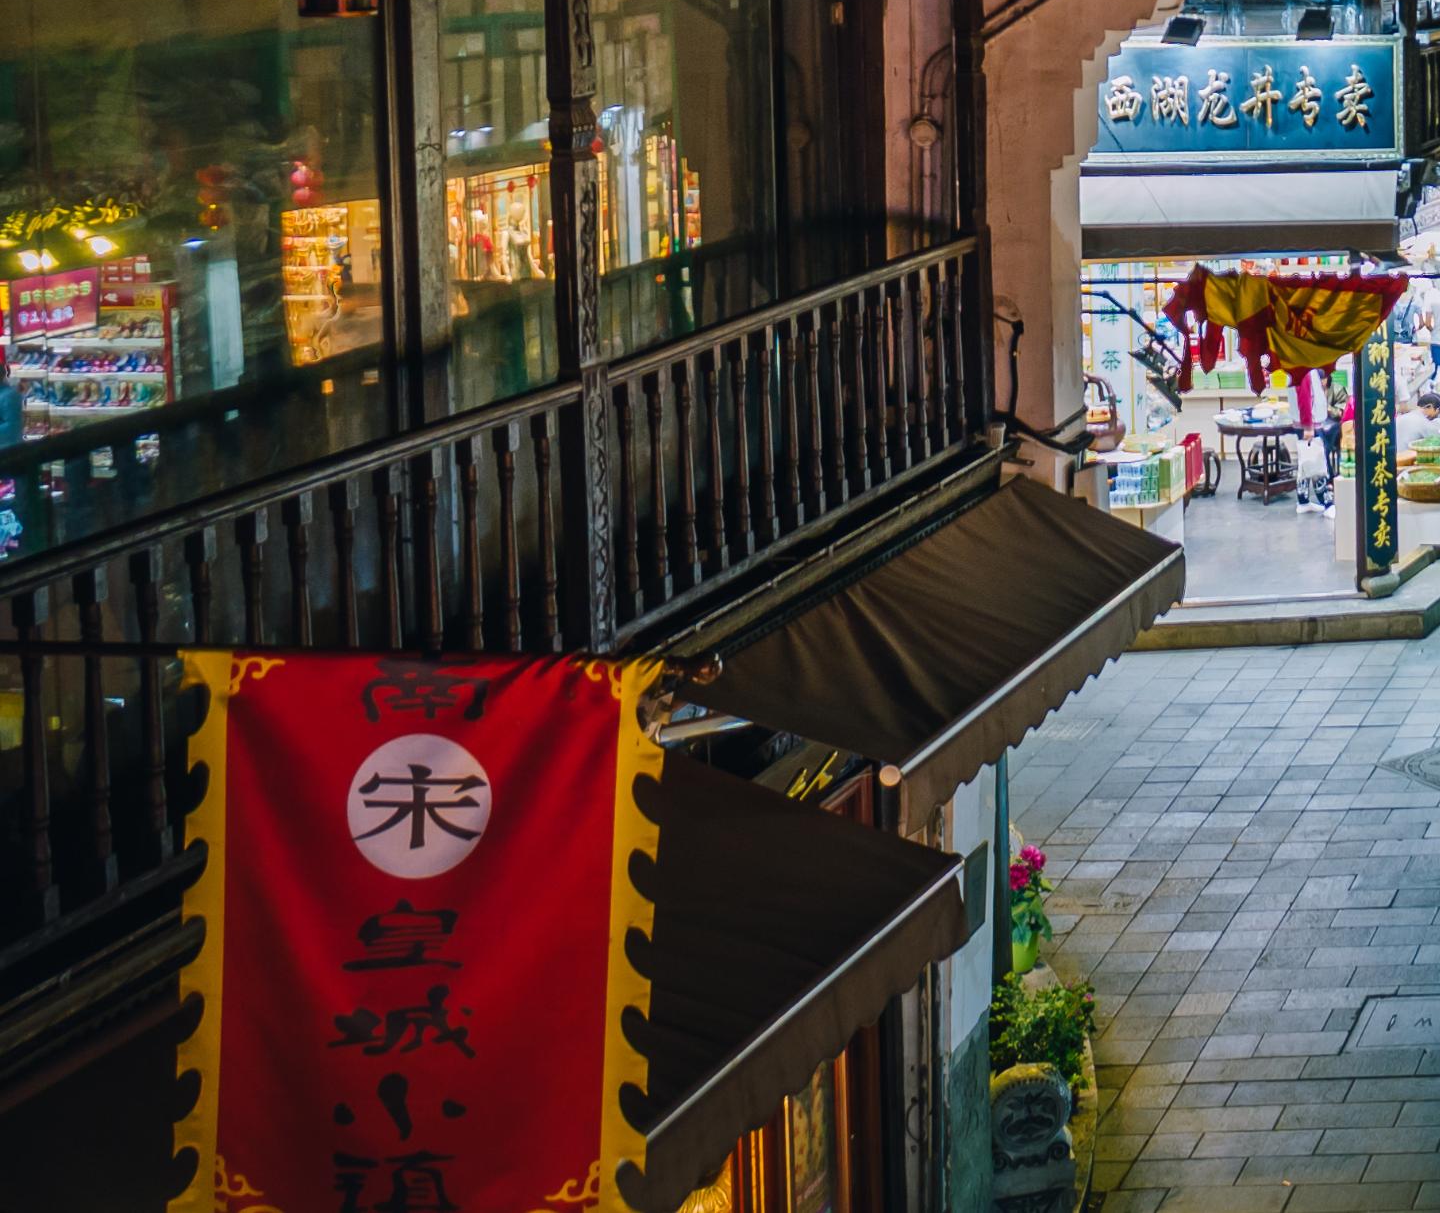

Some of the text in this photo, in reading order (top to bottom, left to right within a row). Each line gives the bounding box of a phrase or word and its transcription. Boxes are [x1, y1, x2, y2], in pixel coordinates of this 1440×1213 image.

[1104, 64, 1373, 129] 西湖龙井专卖
